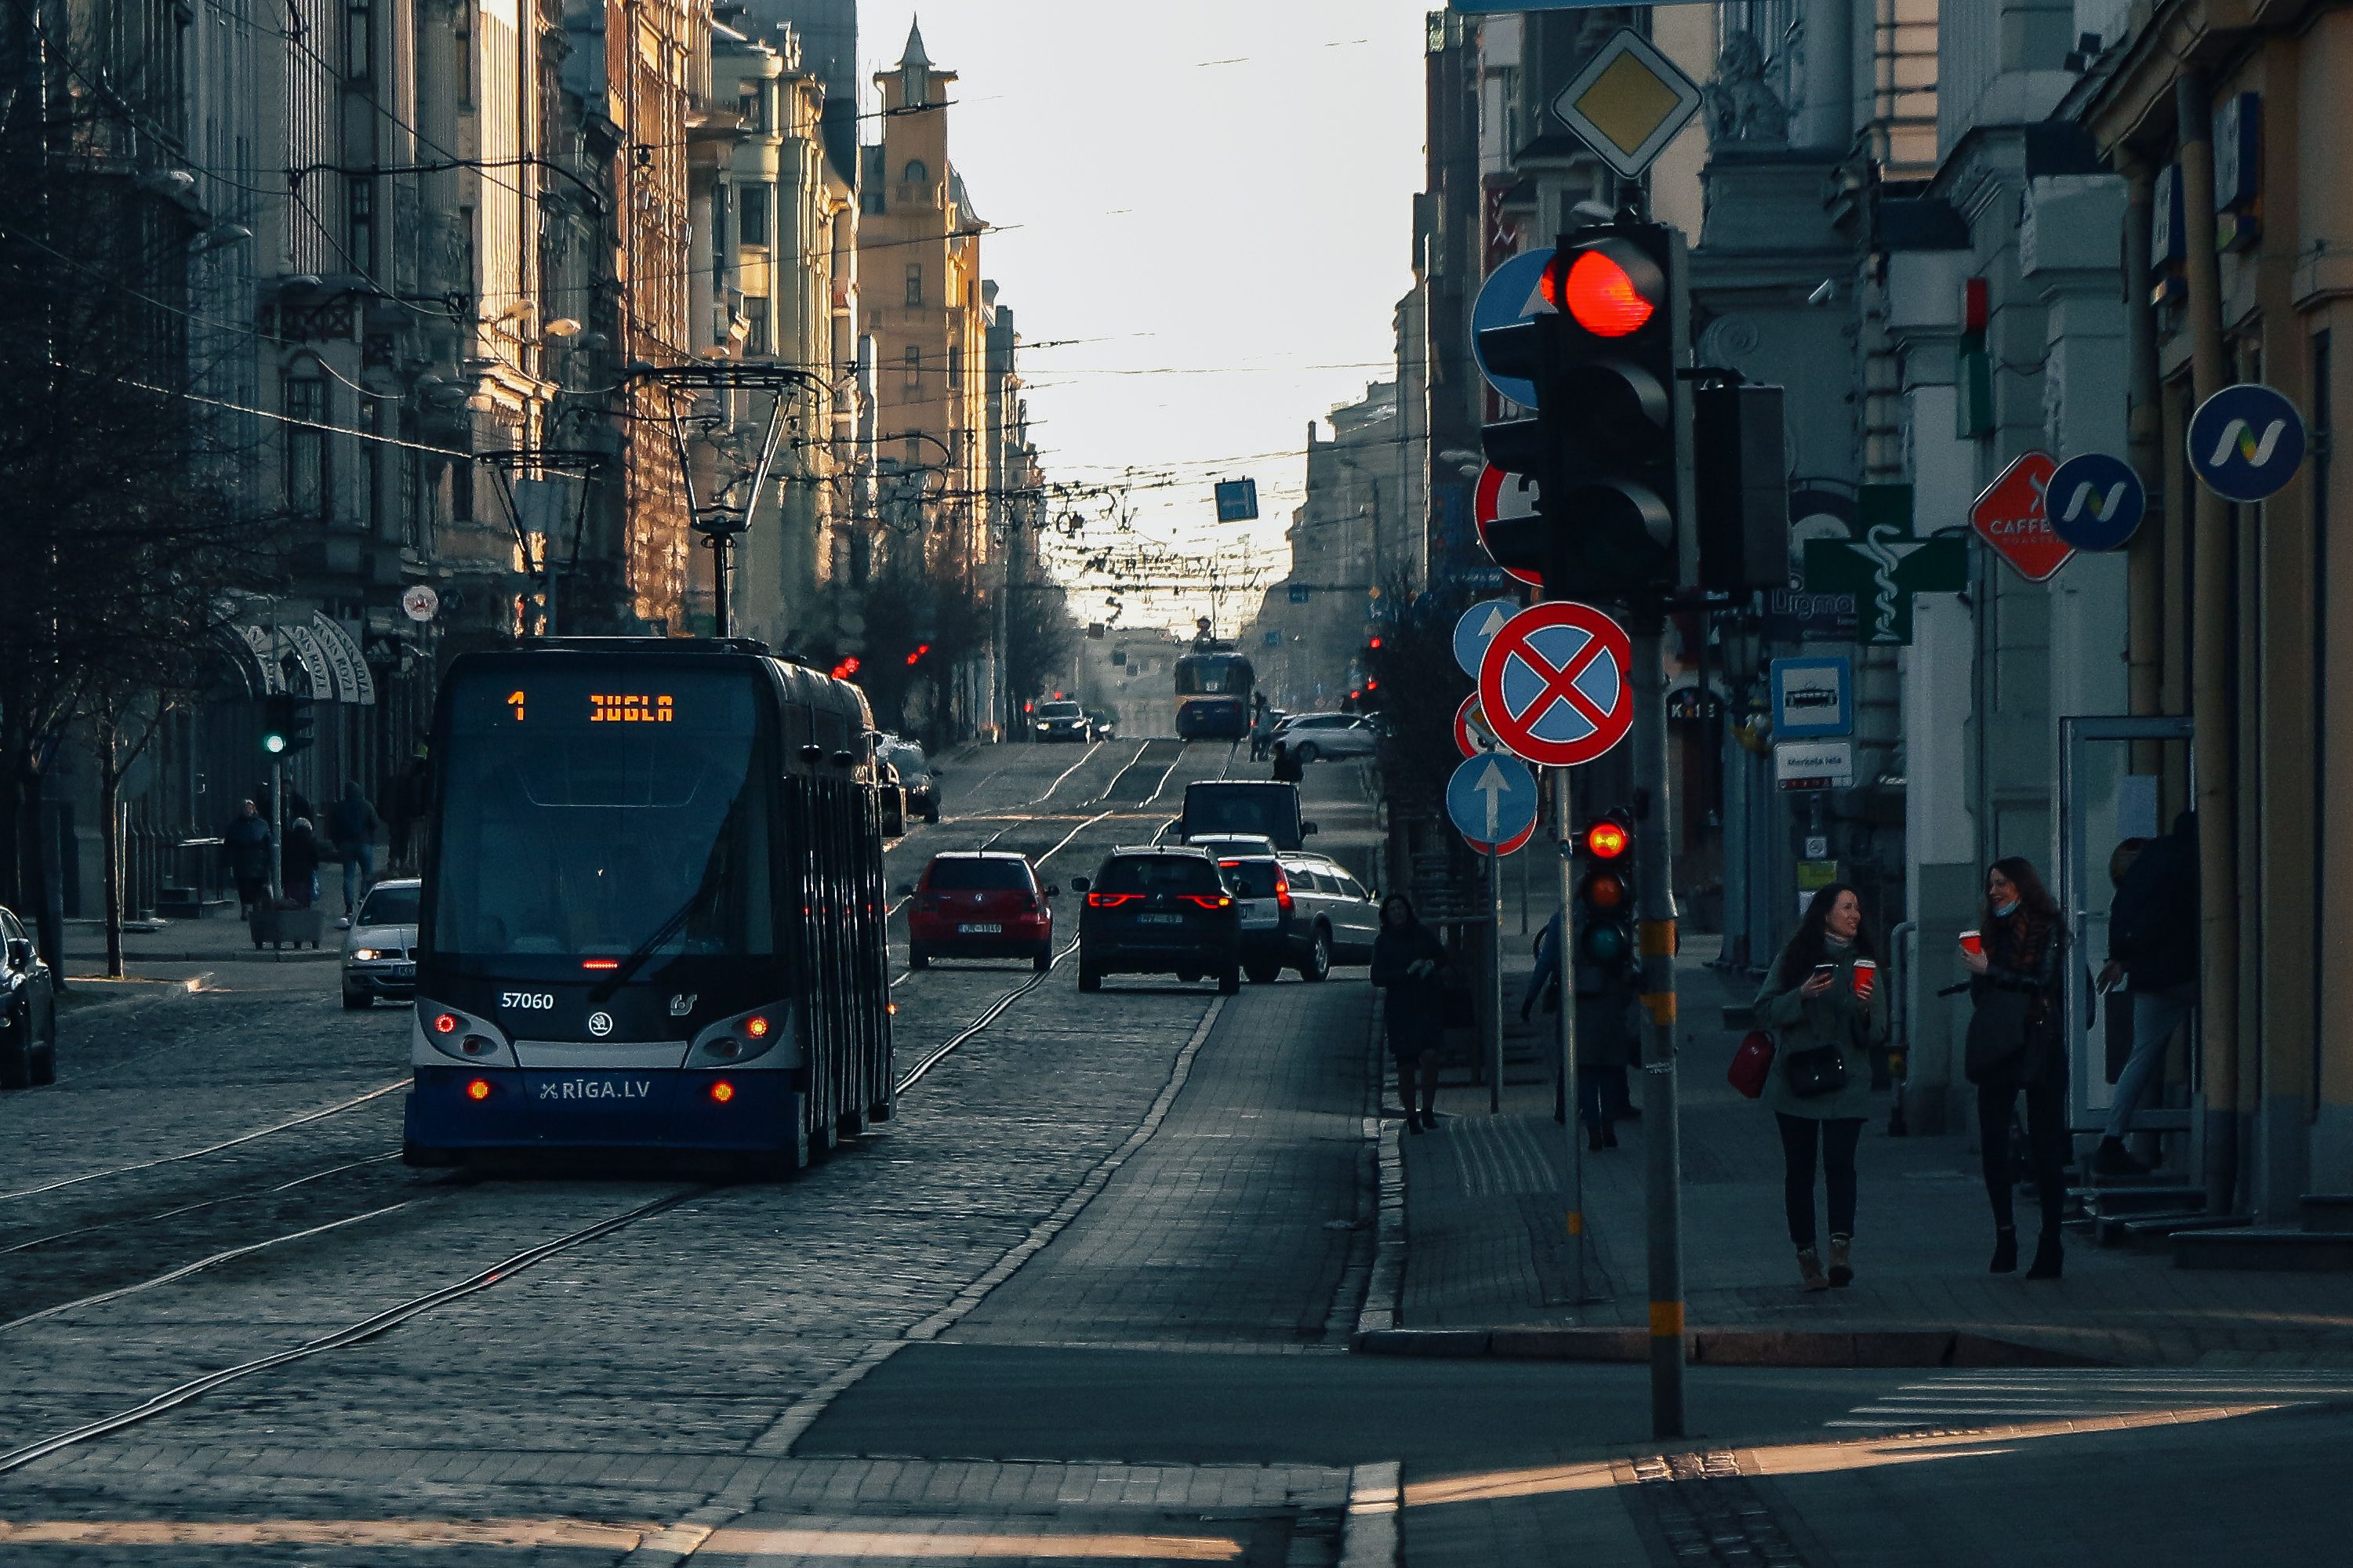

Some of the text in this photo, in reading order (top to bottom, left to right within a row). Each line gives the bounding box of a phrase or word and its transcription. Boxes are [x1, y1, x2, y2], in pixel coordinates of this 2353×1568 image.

[507, 690, 674, 722] 1 JUGLA
[501, 992, 554, 1010] 57060
[562, 1079, 650, 1099] RĪGA.LV
